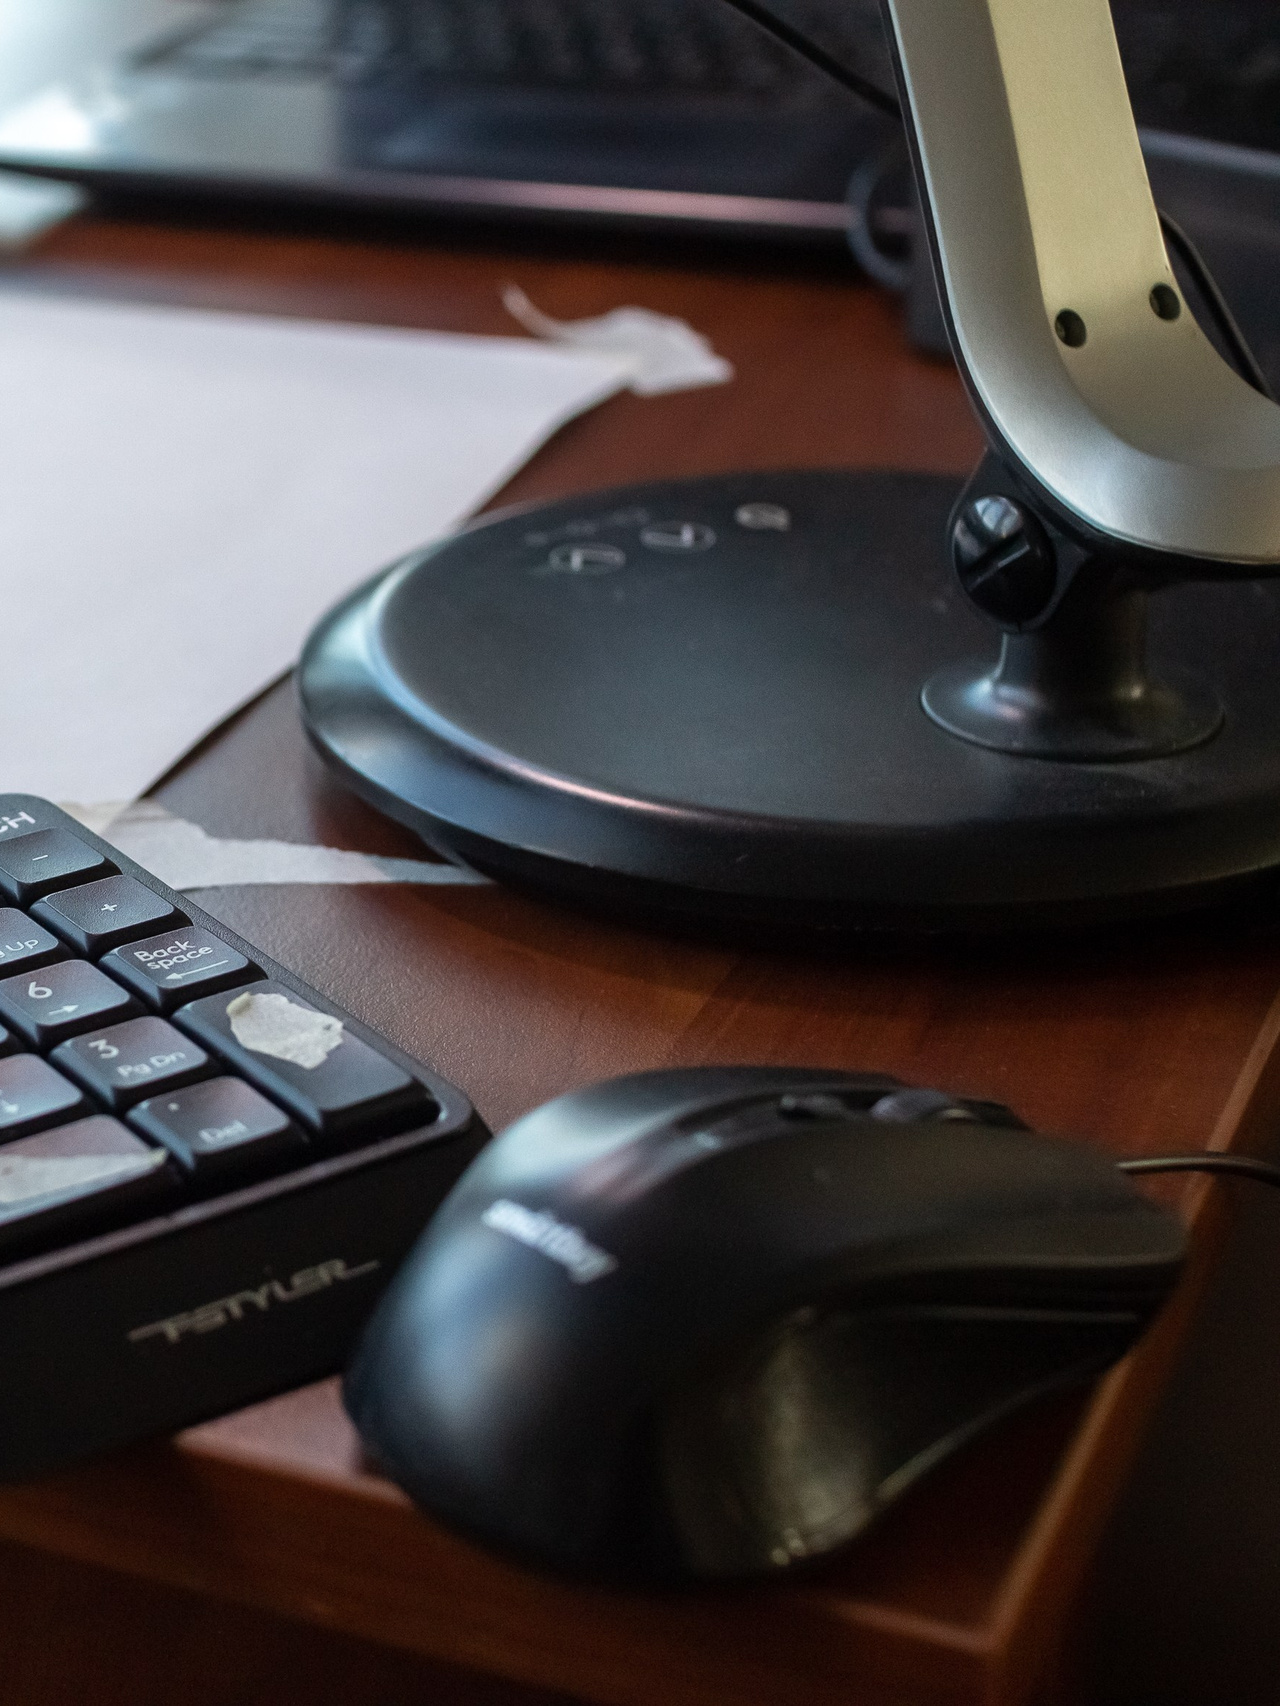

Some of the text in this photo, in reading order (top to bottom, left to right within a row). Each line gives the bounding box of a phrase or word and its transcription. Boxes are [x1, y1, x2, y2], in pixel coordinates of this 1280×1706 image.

[5, 939, 39, 951] Up
[133, 940, 195, 961] Back
[146, 946, 213, 970] space
[28, 982, 53, 999] 6
[88, 1039, 120, 1059] 3
